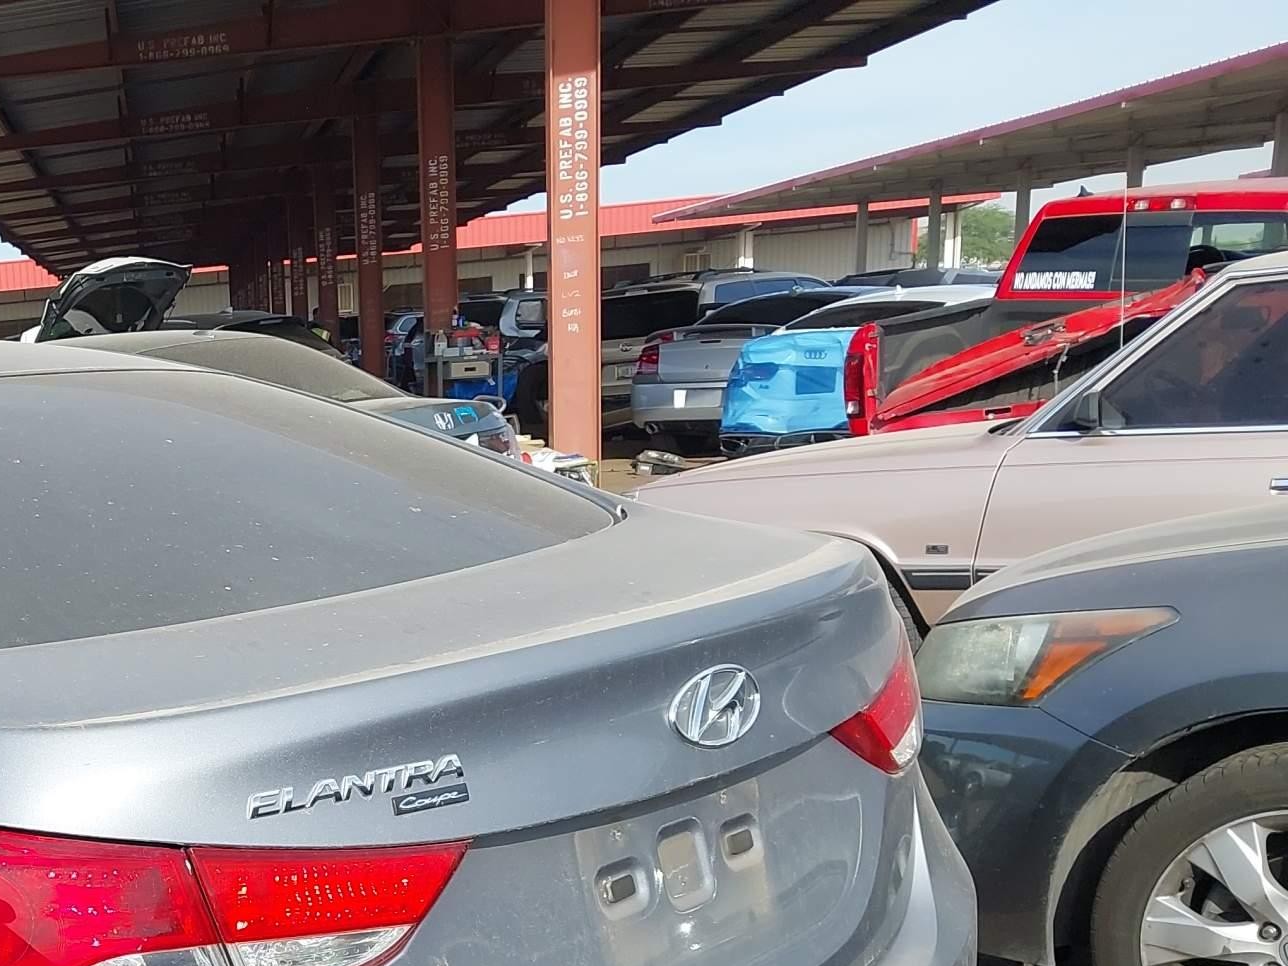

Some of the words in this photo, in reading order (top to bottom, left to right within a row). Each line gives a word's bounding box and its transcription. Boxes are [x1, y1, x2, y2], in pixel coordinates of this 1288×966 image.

[558, 77, 572, 109] INC.
[559, 116, 572, 180] PREFAB
[574, 77, 589, 216] 1-866-799-0969
[429, 182, 439, 225] PREFAB
[559, 187, 573, 219] U.S.
[430, 229, 440, 251] U.S.
[1013, 272, 1024, 290] NO
[1022, 271, 1053, 290] ANDAMOS
[1052, 271, 1067, 290] CON
[247, 753, 464, 819] ELANTRA
[396, 788, 469, 811] Coupe
